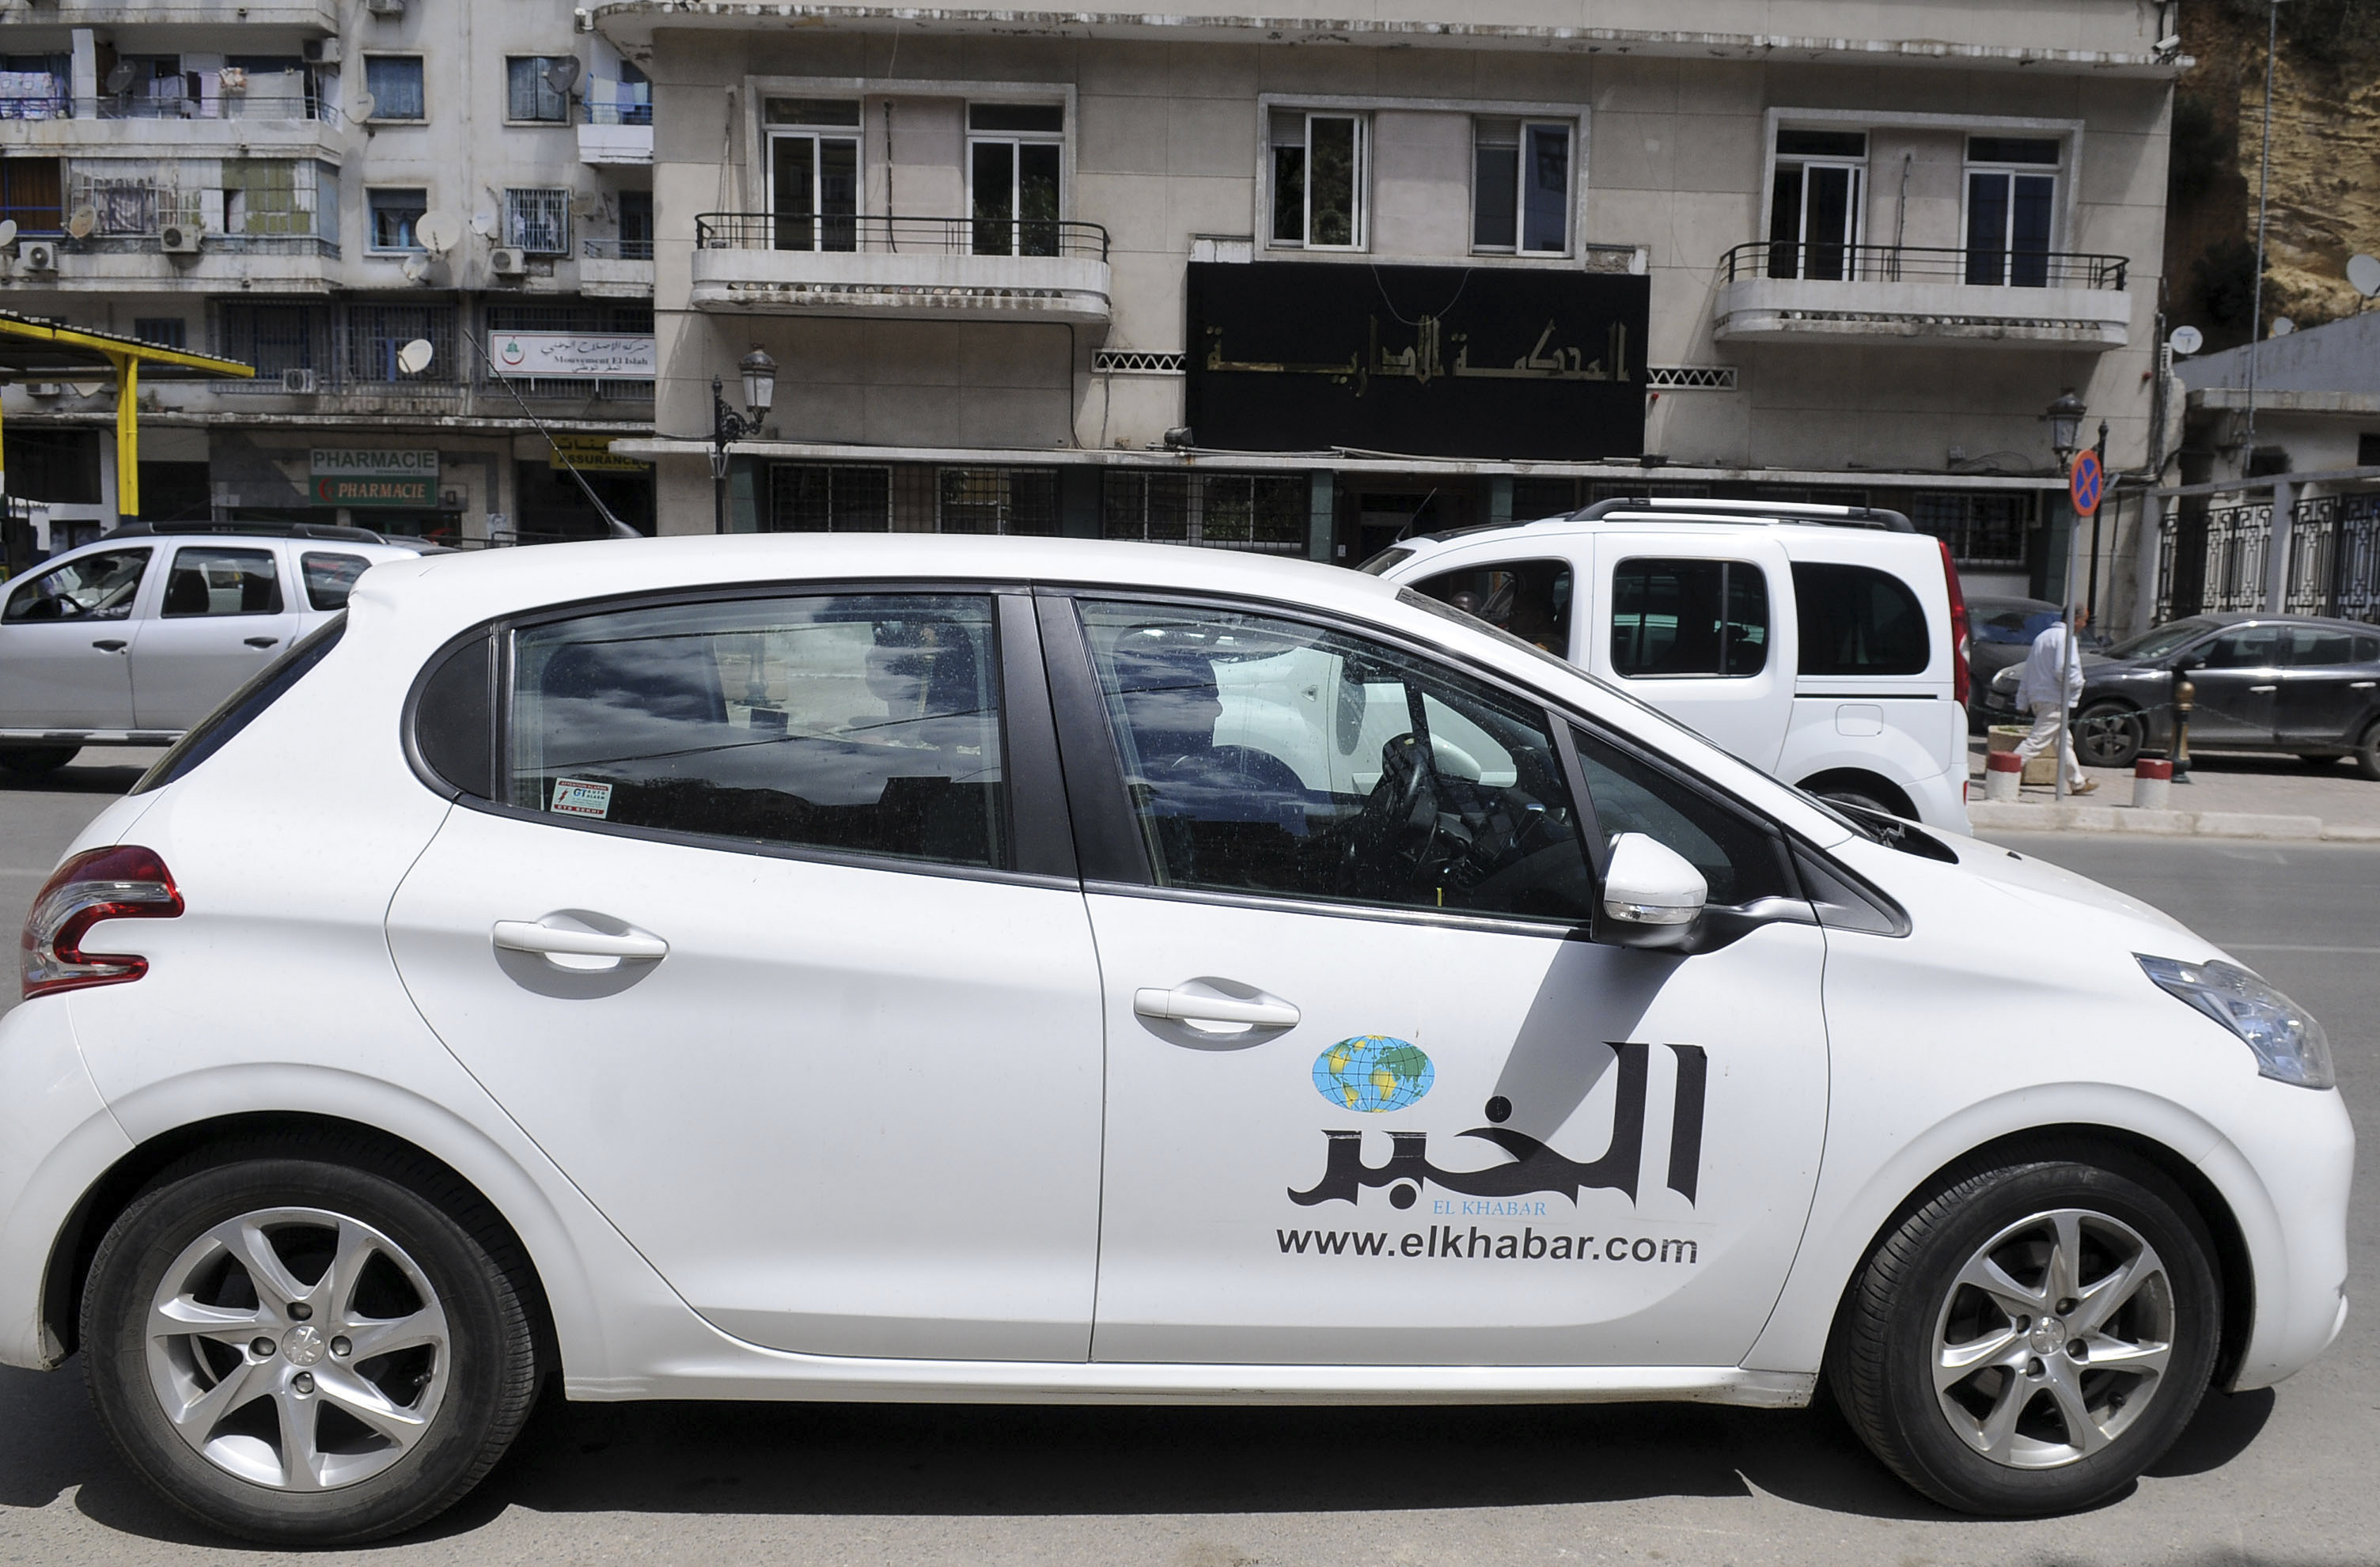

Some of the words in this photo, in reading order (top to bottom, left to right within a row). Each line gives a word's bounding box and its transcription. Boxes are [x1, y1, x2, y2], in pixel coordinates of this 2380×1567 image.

[554, 355, 609, 365] Mouvement
[313, 451, 435, 469] PHARMACIE
[337, 483, 426, 499] PHARMACIE
[573, 788, 587, 797] GT
[1287, 1040, 1707, 1211] الخبر
[1432, 1199, 1455, 1215] EL
[1461, 1200, 1548, 1217] KHABAR
[1275, 1224, 1699, 1265] www.elkhabar.com
